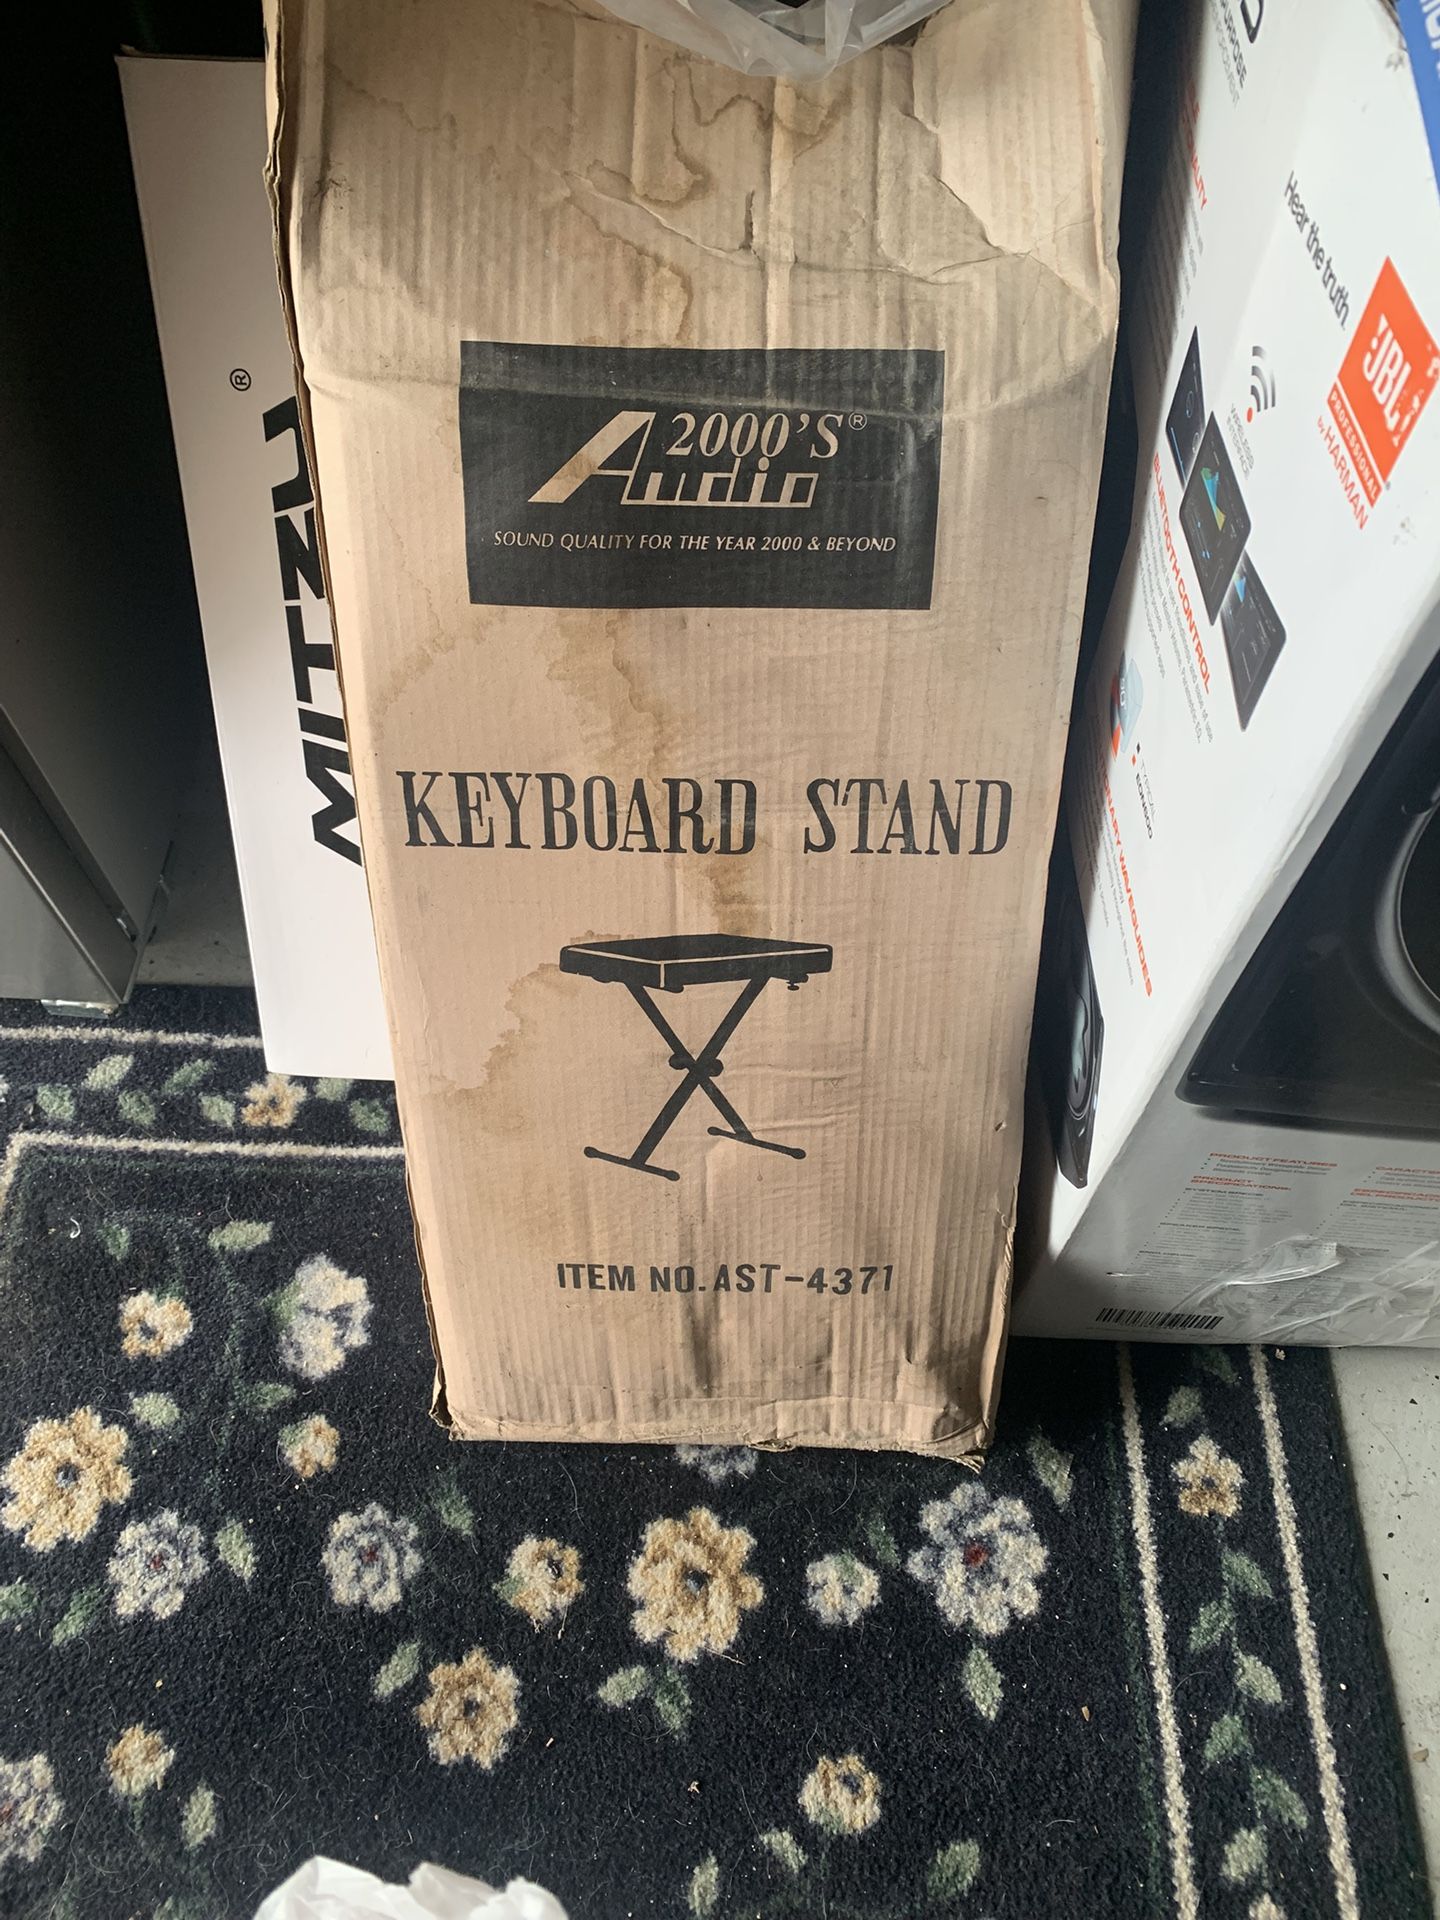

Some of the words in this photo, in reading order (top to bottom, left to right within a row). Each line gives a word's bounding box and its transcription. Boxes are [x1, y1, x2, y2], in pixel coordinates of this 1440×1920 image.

[1221, 0, 1247, 89] URPOSE
[1284, 170, 1309, 233] Hear
[1306, 221, 1325, 271] the
[528, 410, 819, 508] Audio
[1323, 425, 1369, 531] HARMAN
[1330, 390, 1379, 500] PROFESSIONAL
[493, 530, 555, 548] SOUND
[560, 533, 636, 551] QUALITY
[639, 534, 673, 550] FOR
[679, 535, 711, 550] THE
[715, 536, 757, 551] YEAR
[760, 536, 803, 552] 2000
[806, 537, 820, 551] &
[825, 537, 898, 552] BEYOND
[1154, 452, 1181, 581] BLUETOOTH
[1177, 578, 1211, 695] CONTROL
[262, 395, 363, 867] MITZU
[396, 770, 758, 855] KEYBOARD
[803, 777, 1014, 856] STAND
[1119, 849, 1153, 997] WAVEGUIDES
[556, 1263, 636, 1292] ITEM
